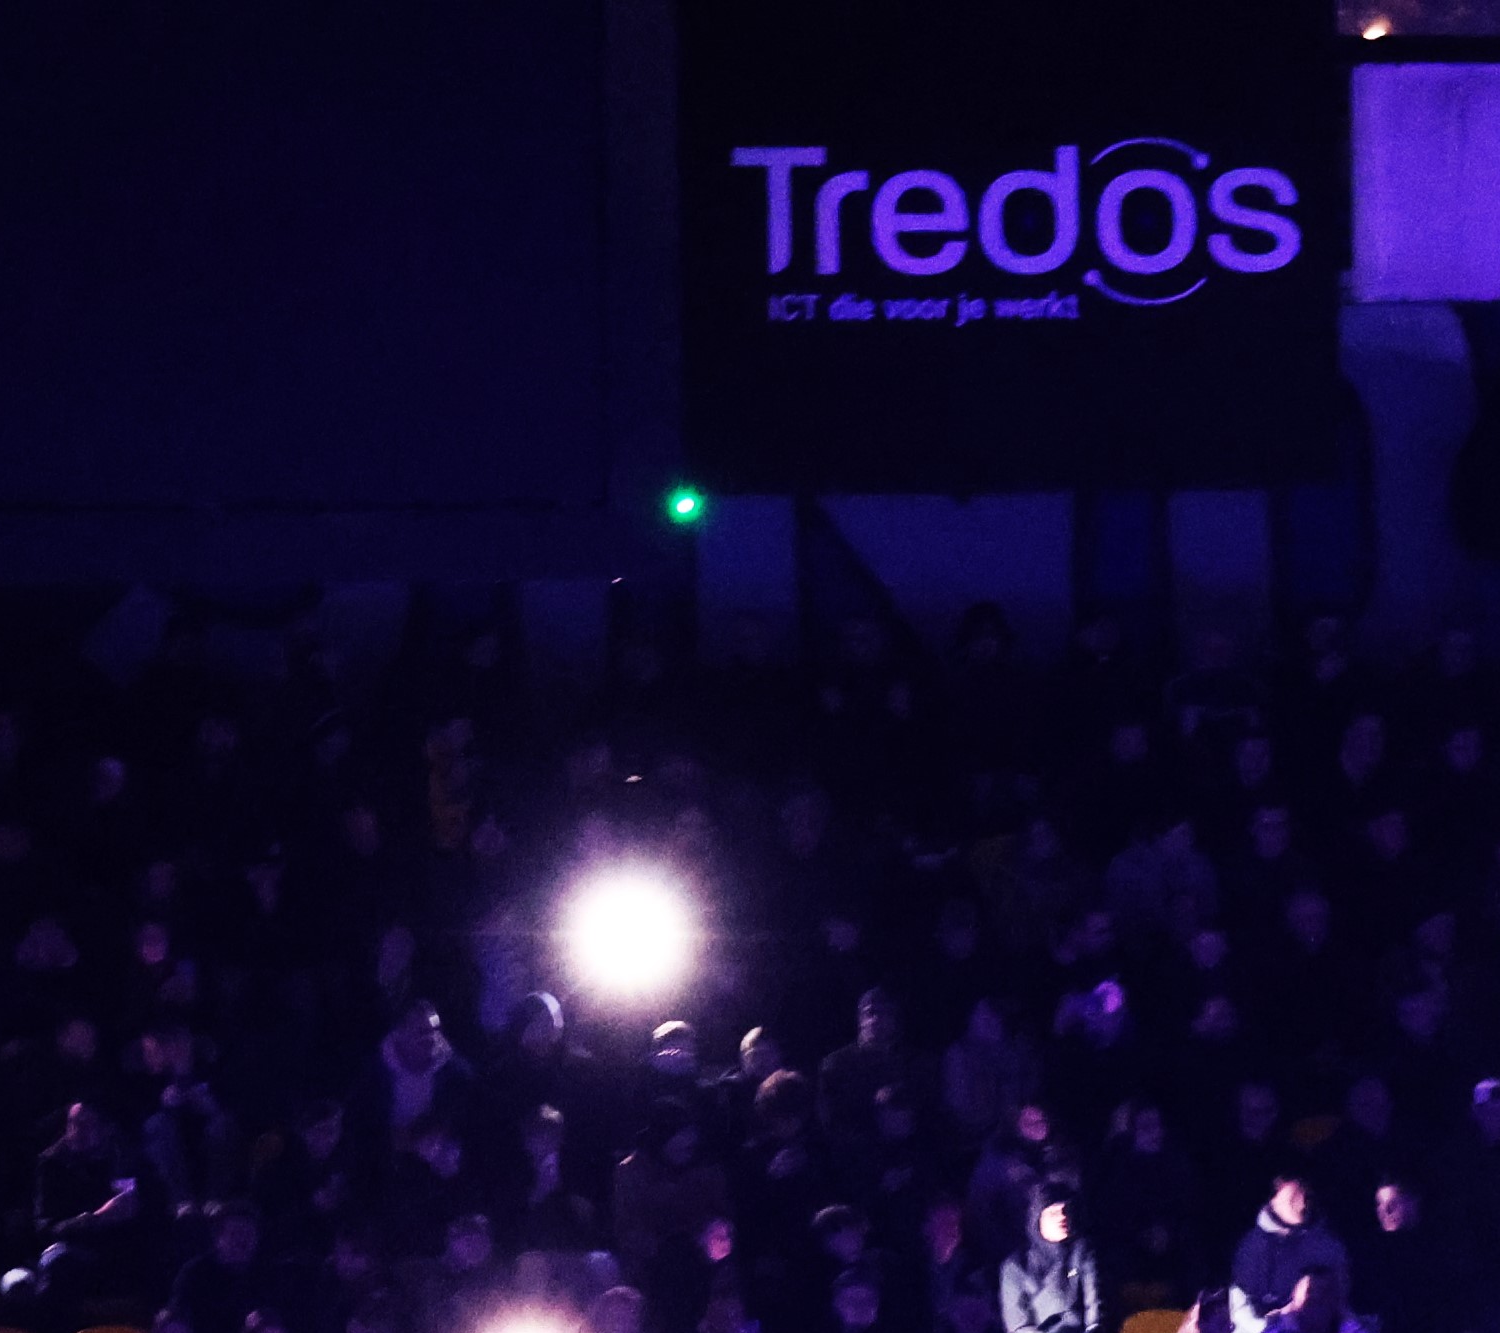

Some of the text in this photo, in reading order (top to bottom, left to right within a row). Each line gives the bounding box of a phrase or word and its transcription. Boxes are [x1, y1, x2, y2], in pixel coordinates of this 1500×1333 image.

[730, 143, 1301, 276] Tredos
[767, 294, 821, 321] ICT
[828, 293, 876, 321] die
[883, 299, 950, 321] voor
[955, 293, 986, 327] je
